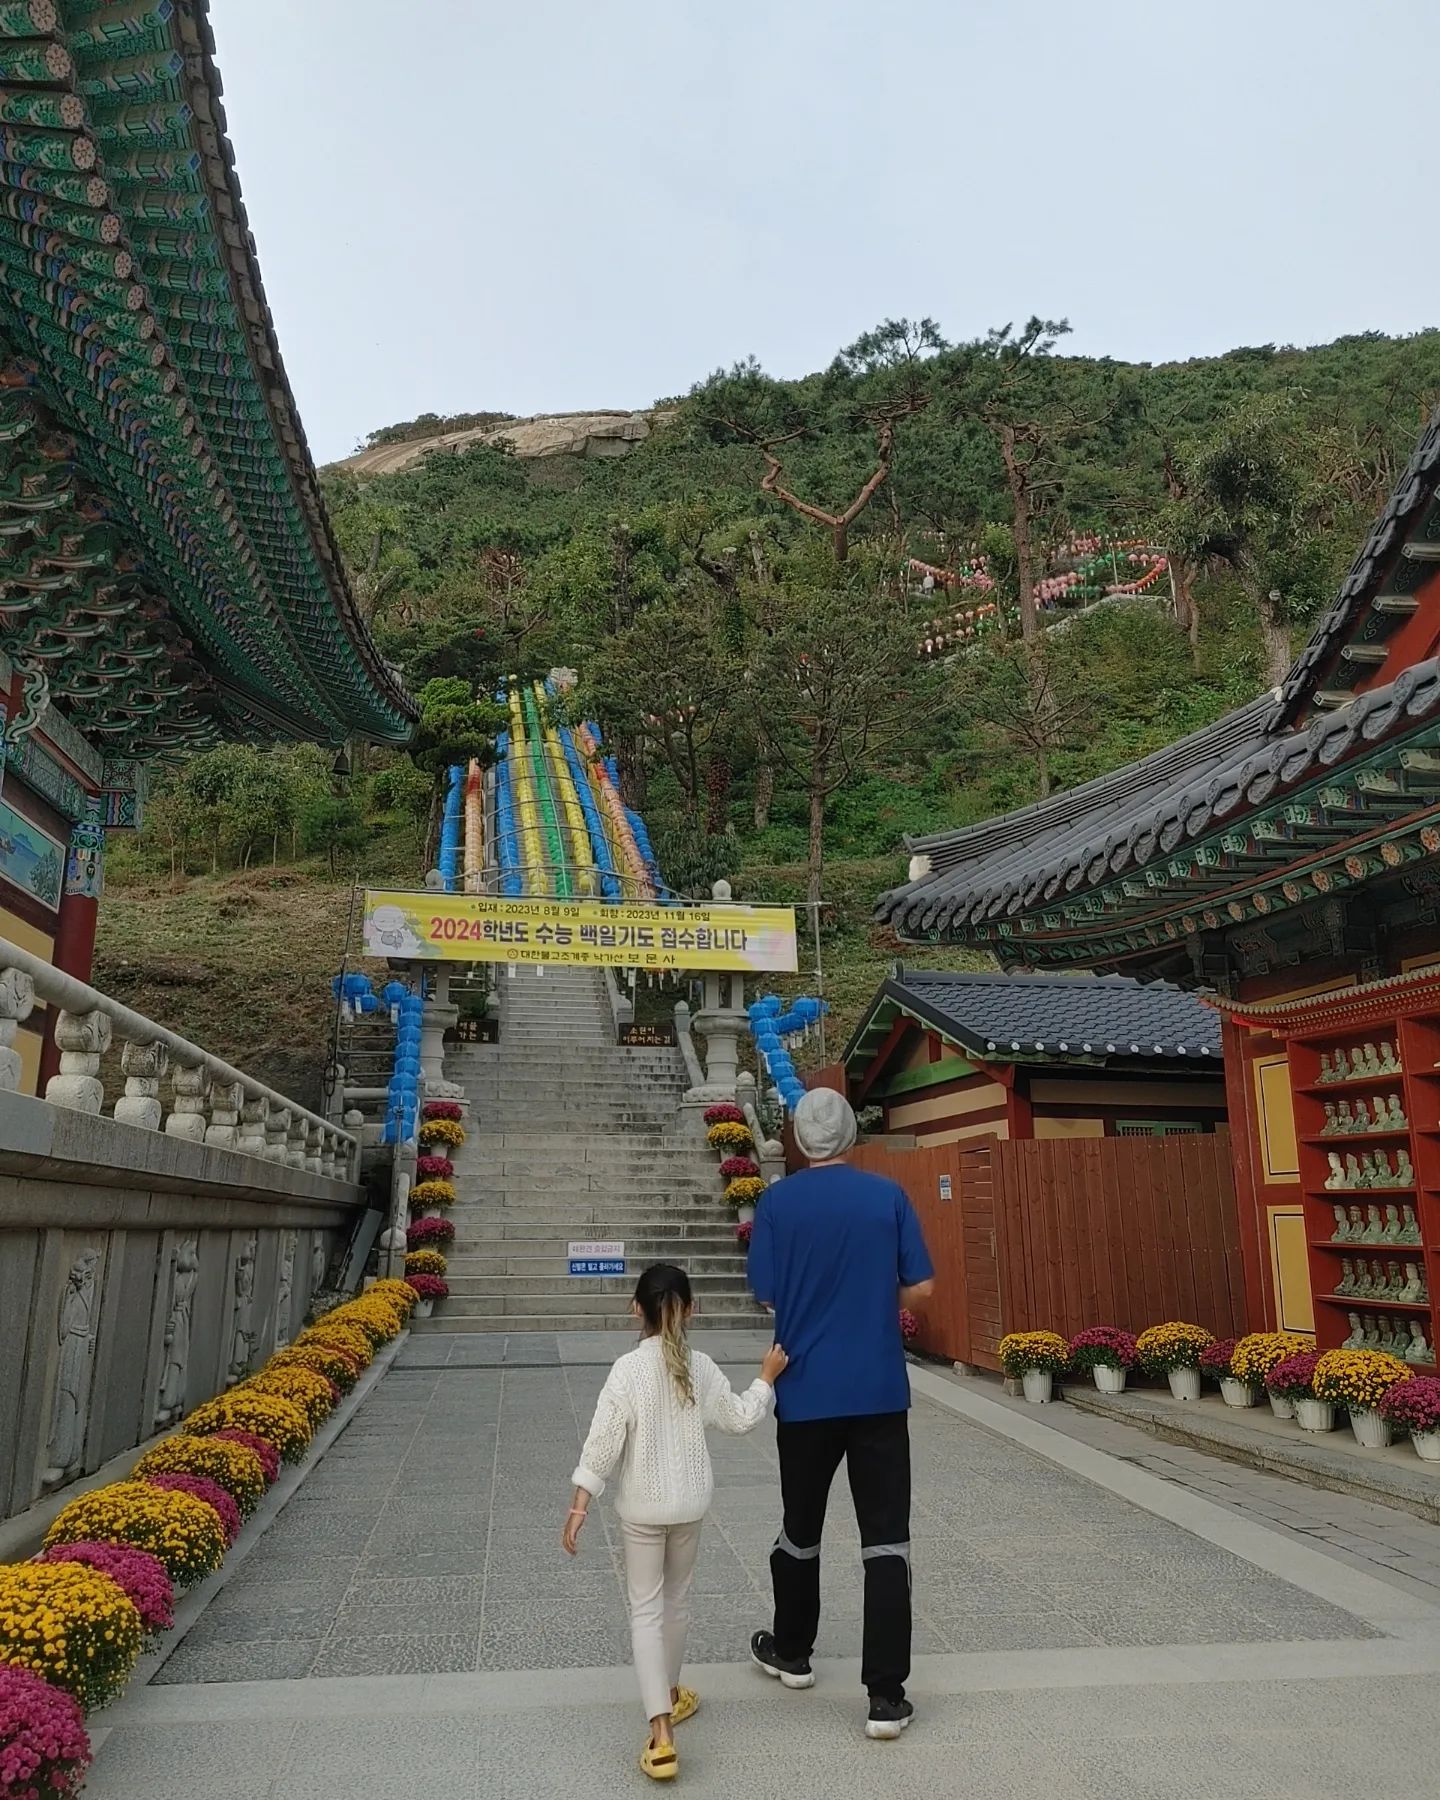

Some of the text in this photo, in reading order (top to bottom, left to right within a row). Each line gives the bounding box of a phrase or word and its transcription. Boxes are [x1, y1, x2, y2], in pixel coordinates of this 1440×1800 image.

[477, 902, 498, 914] 입재
[505, 903, 540, 916] 2023년
[544, 905, 560, 917] 8월
[563, 906, 580, 917] 9일
[600, 908, 619, 919] 회향
[626, 909, 660, 921] 2023년
[664, 911, 685, 921] 11월
[689, 911, 711, 922] 16일
[430, 917, 748, 951] 2024학년도 수능 백일기도 접수합니다
[520, 950, 590, 962] 대한불교조계종
[593, 953, 625, 963] 낙가산
